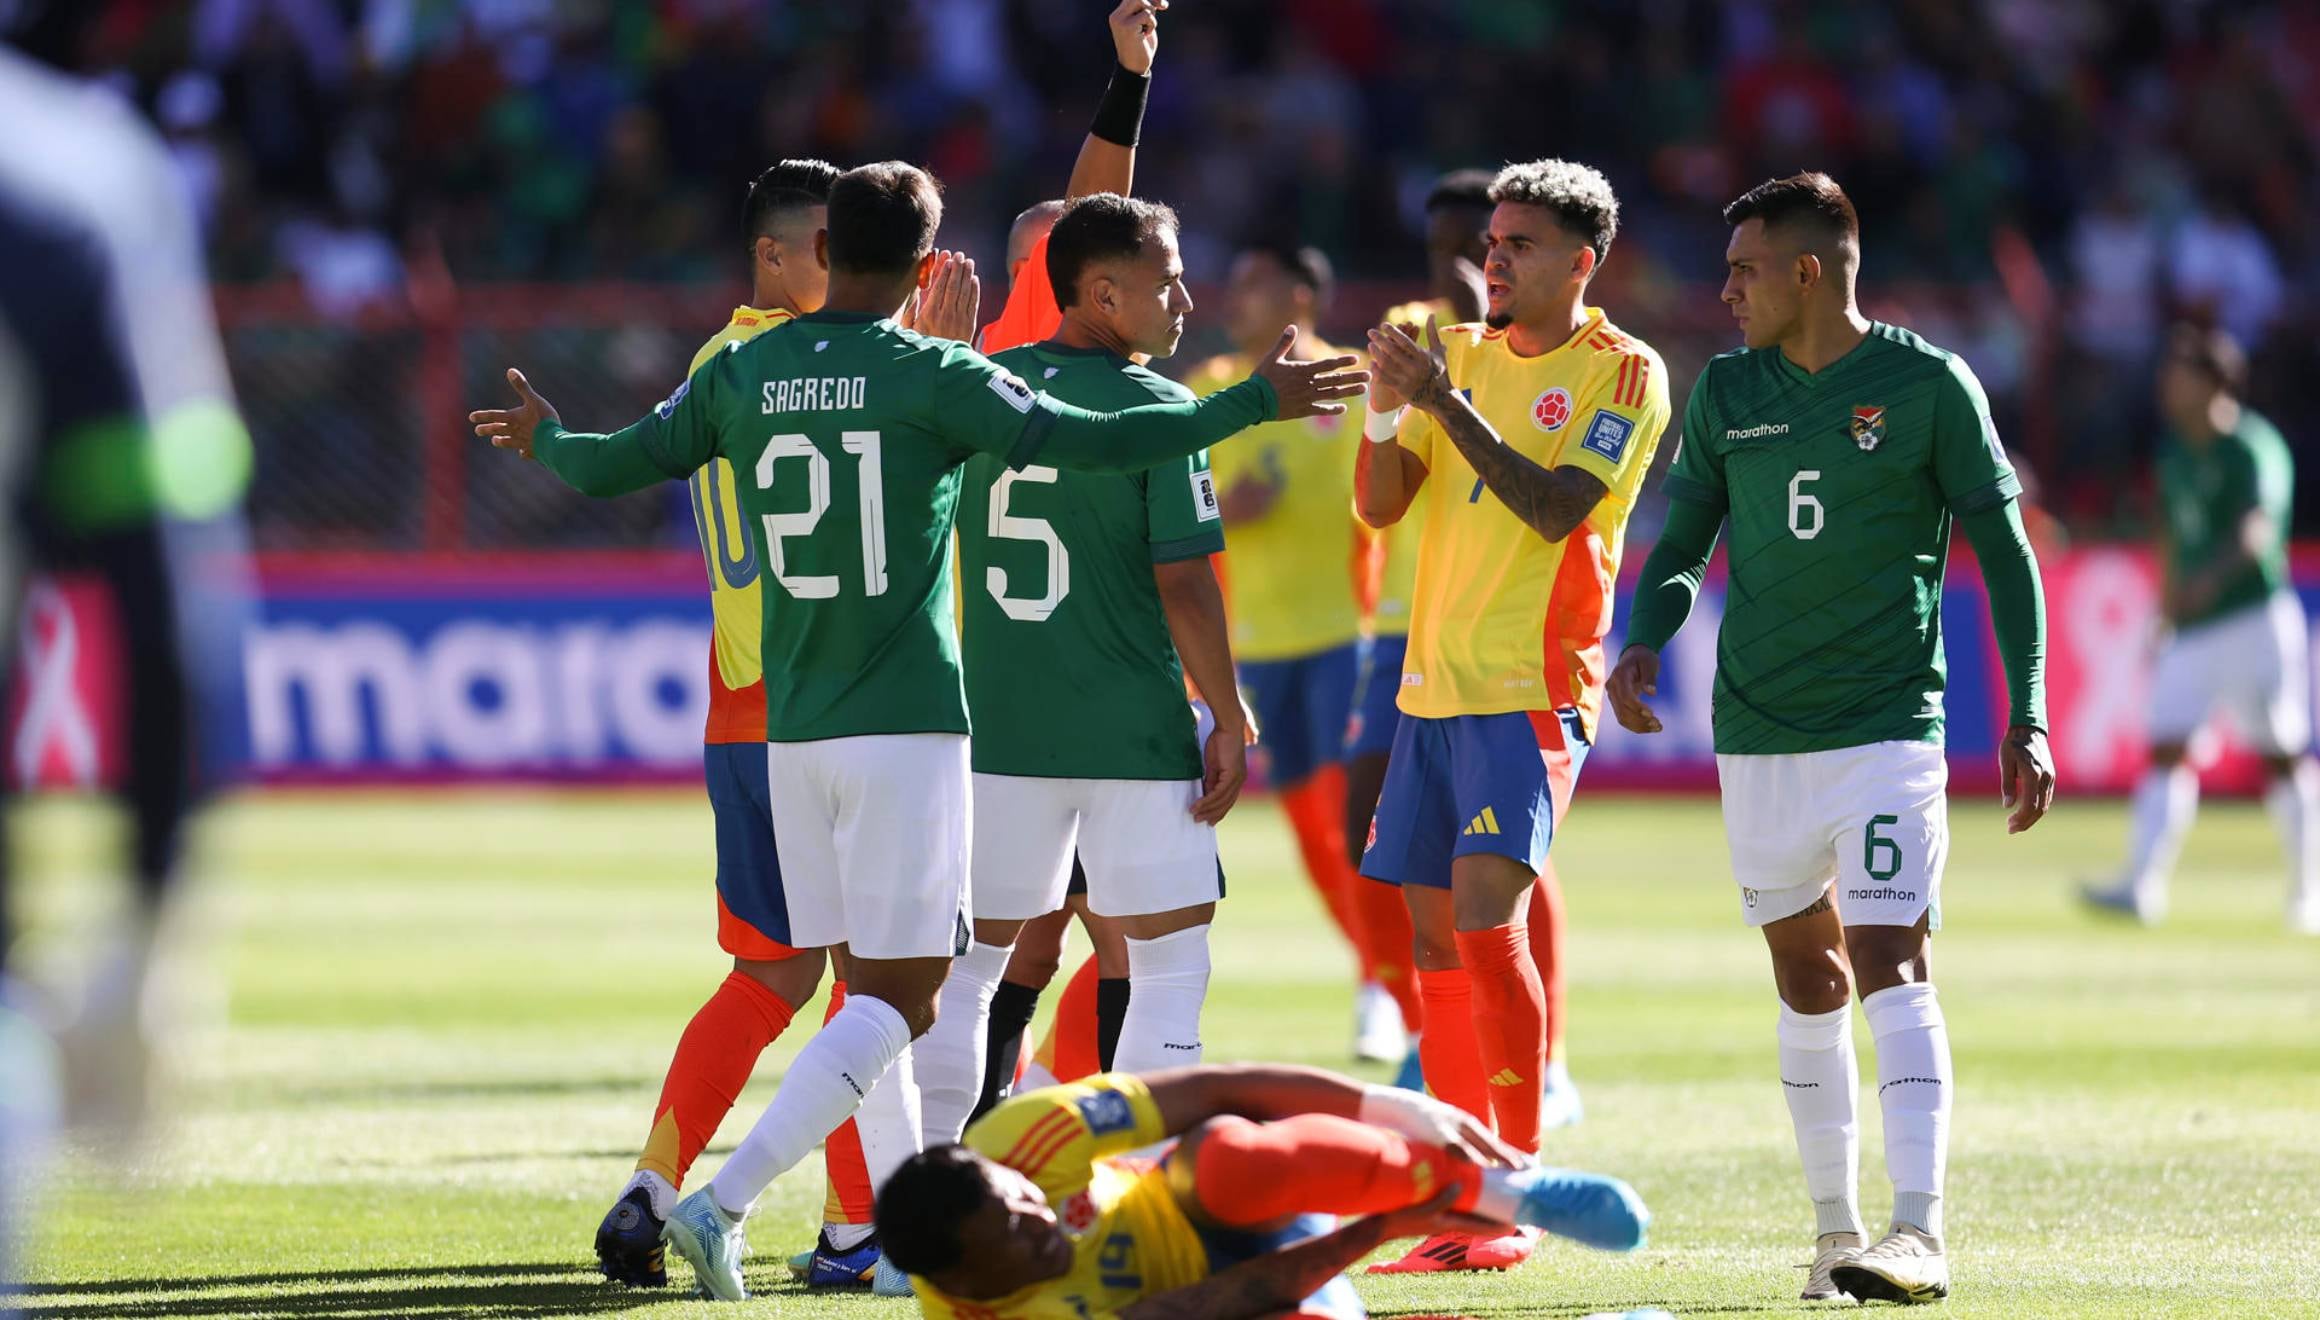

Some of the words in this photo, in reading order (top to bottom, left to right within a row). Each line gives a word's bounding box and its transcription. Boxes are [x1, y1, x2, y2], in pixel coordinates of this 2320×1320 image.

[762, 377, 866, 415] SAGREDO
[1727, 424, 1789, 440] marathon
[755, 430, 889, 599] 21
[1788, 470, 1824, 540] 6
[986, 464, 1070, 622] 5
[1864, 814, 1902, 881] 6
[1848, 887, 1916, 902] marathon
